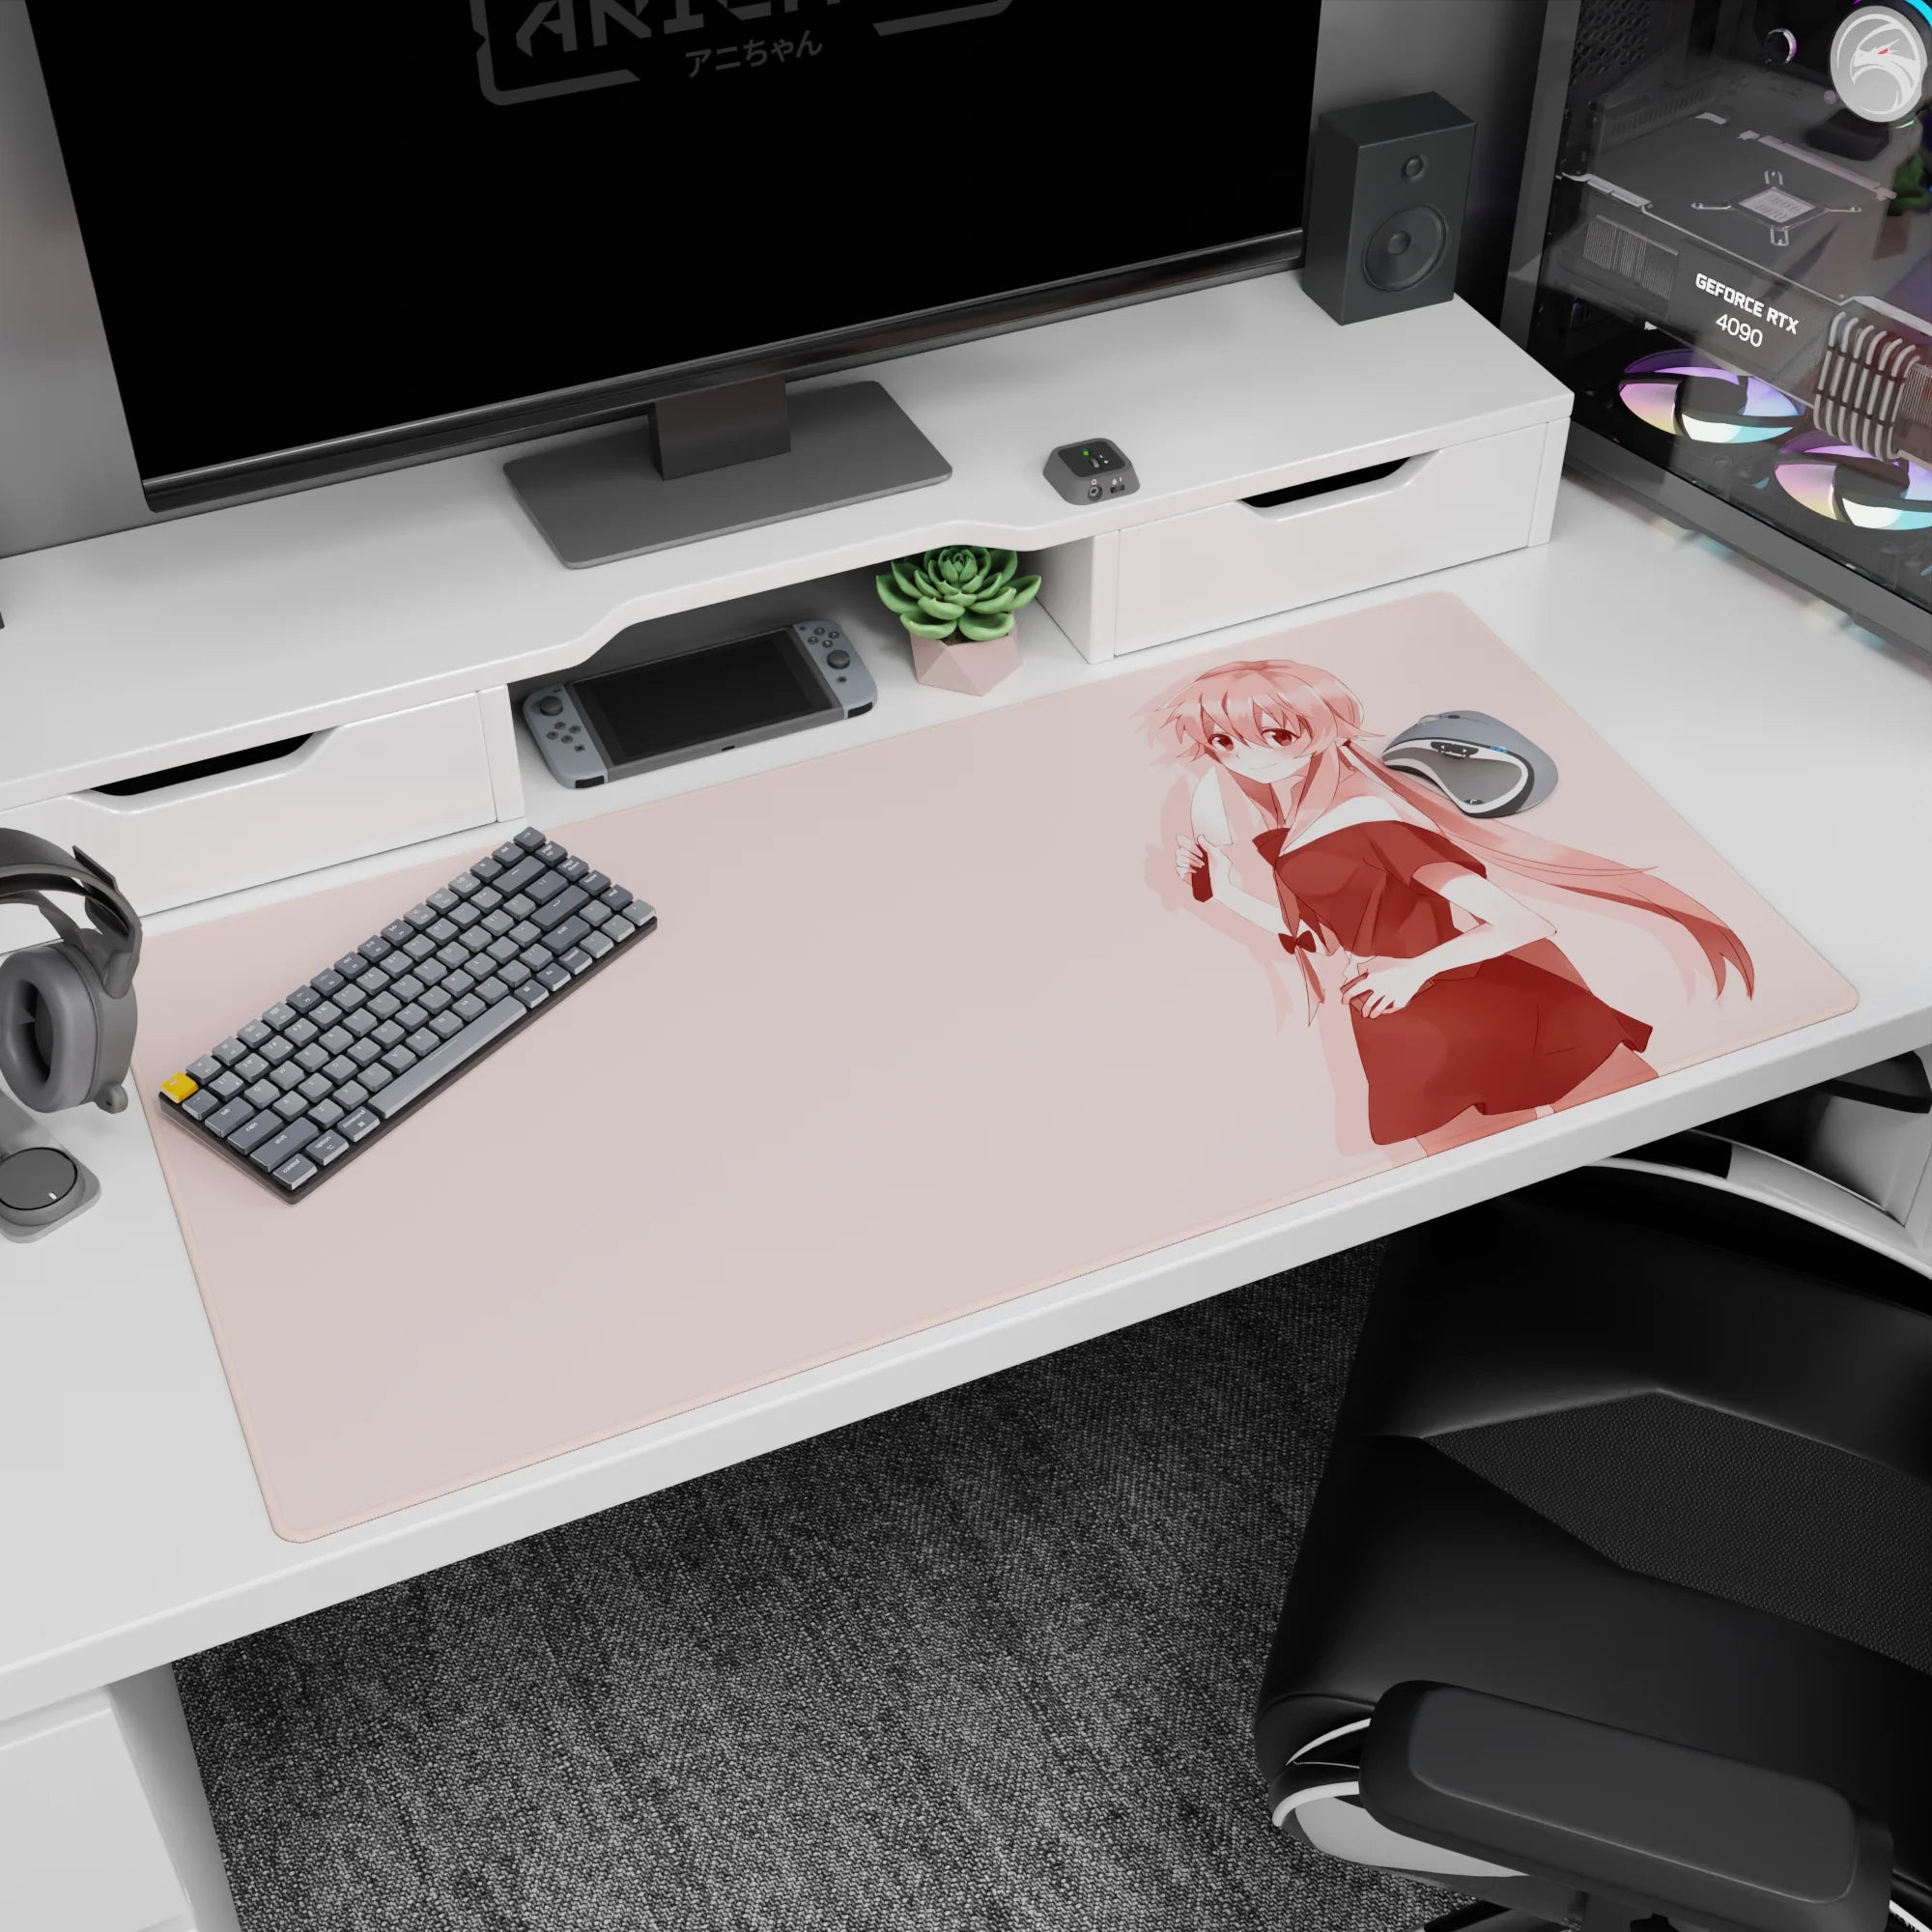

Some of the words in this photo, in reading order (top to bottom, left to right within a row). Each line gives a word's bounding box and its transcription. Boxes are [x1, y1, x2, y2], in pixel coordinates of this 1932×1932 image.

[686, 30, 823, 78] アニちゃん
[1695, 272, 1765, 318] GEFORCE
[1766, 306, 1800, 335] RTX
[1716, 314, 1764, 348] 4090
[342, 1109, 366, 1128] command
[315, 1136, 331, 1150] option
[282, 1158, 300, 1174] control
